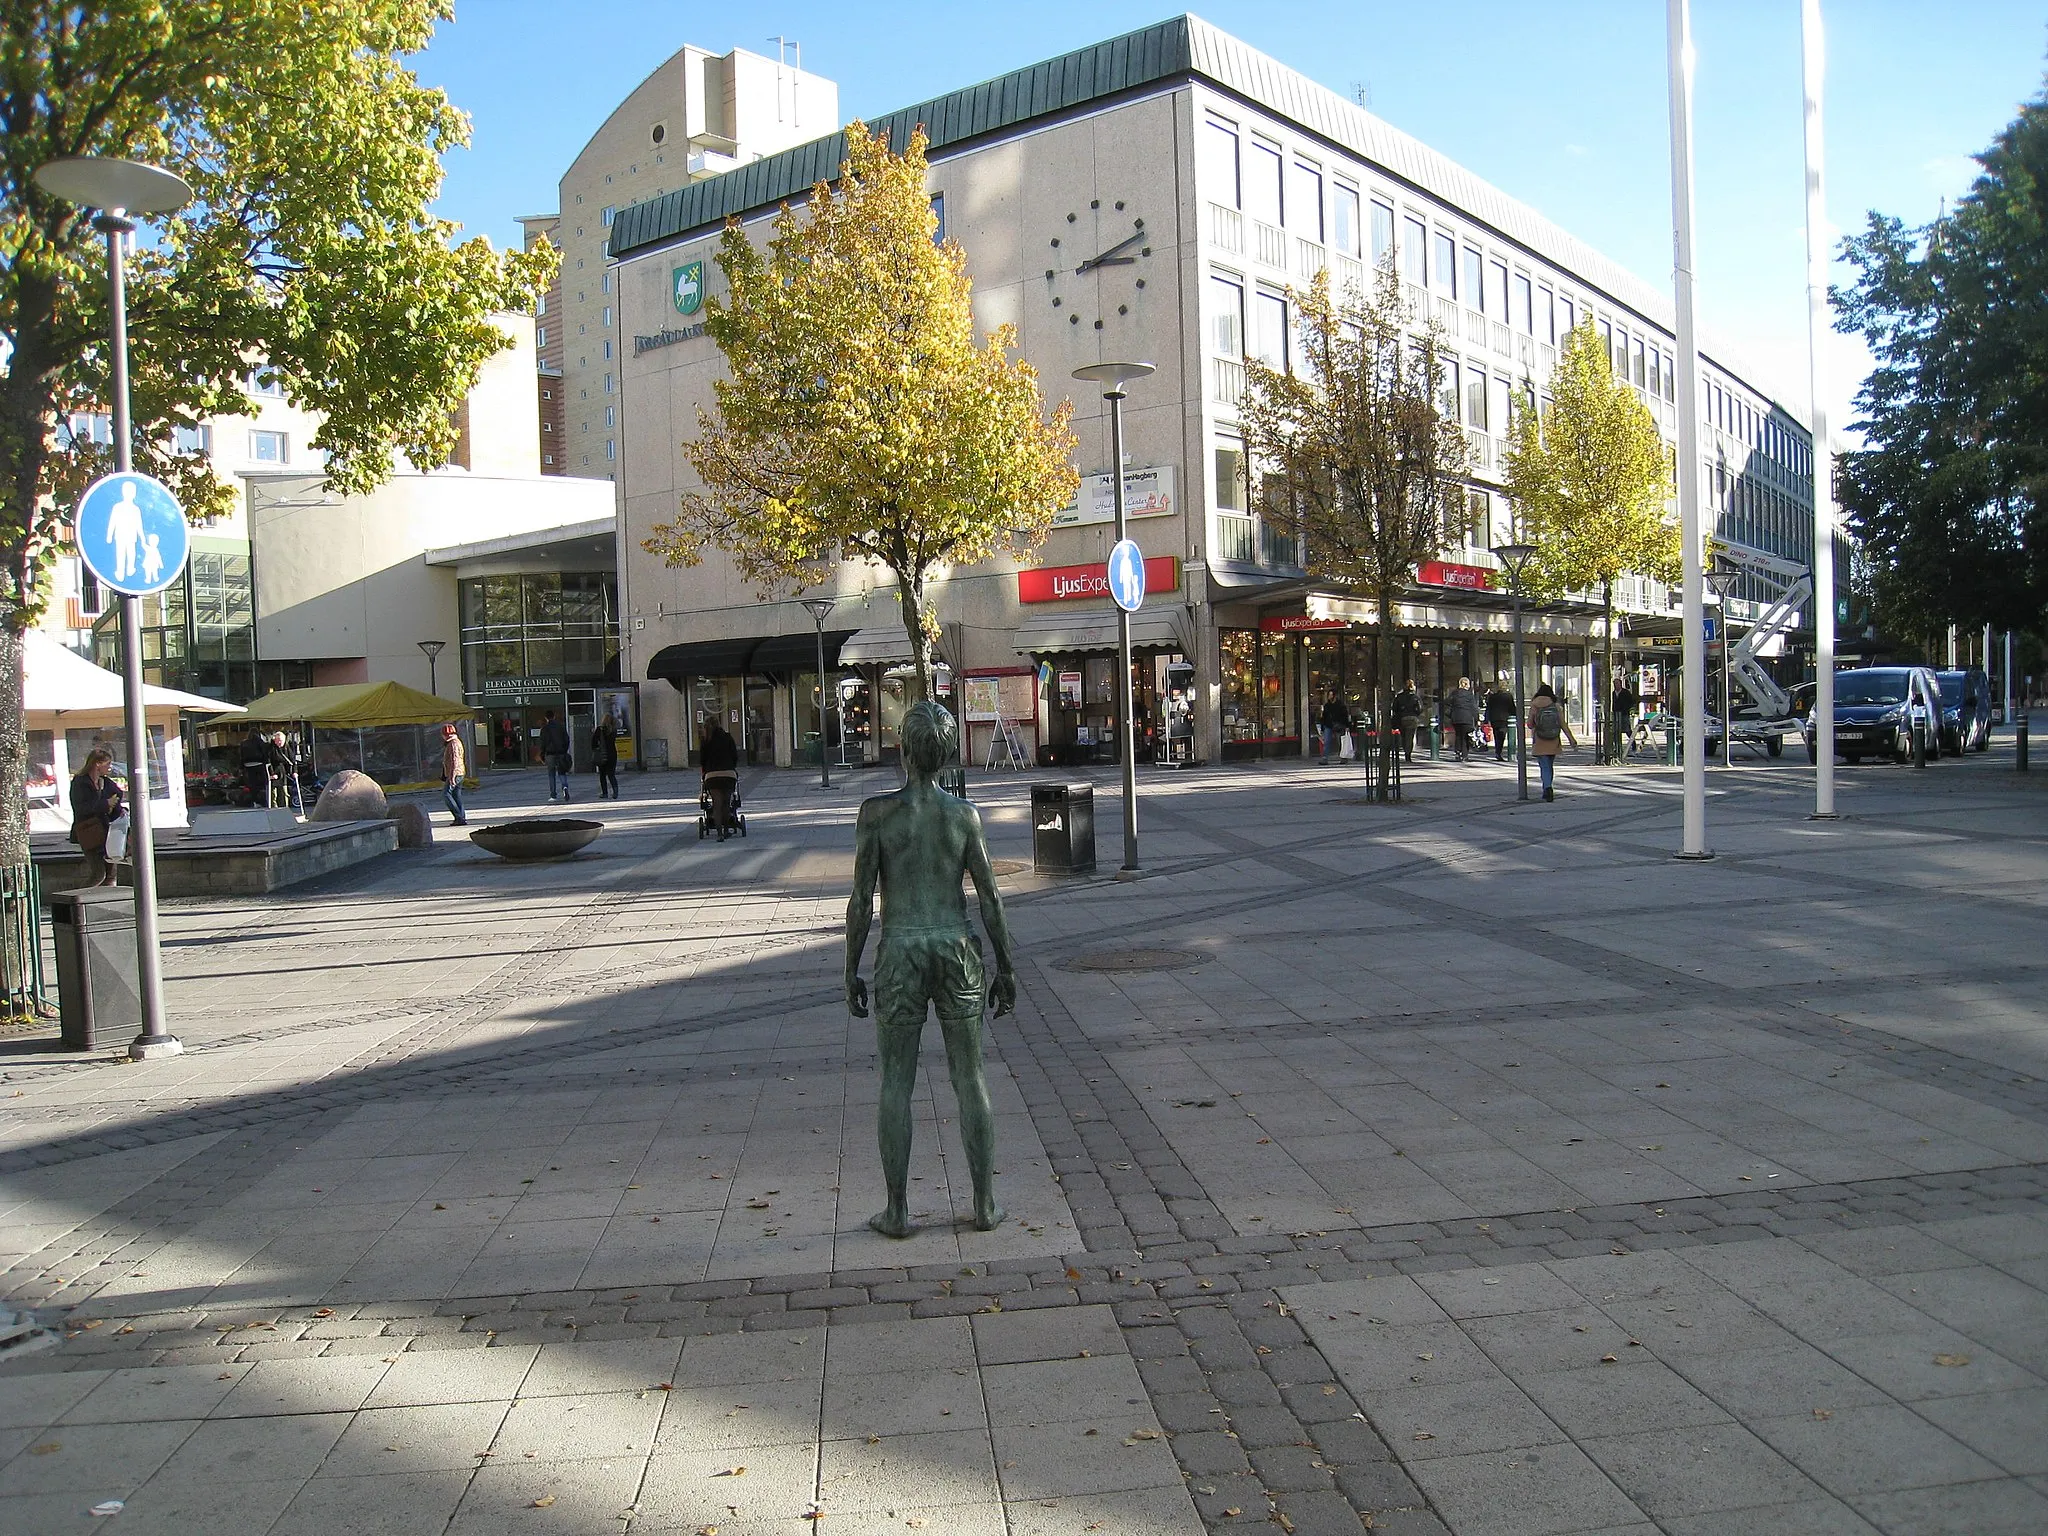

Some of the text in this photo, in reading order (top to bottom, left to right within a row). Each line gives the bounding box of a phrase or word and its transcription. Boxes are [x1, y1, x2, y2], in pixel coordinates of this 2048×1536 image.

[1730, 550, 1747, 559] DINO
[1053, 574, 1109, 597] LjusExpe
[485, 680, 522, 688] ELEGANT
